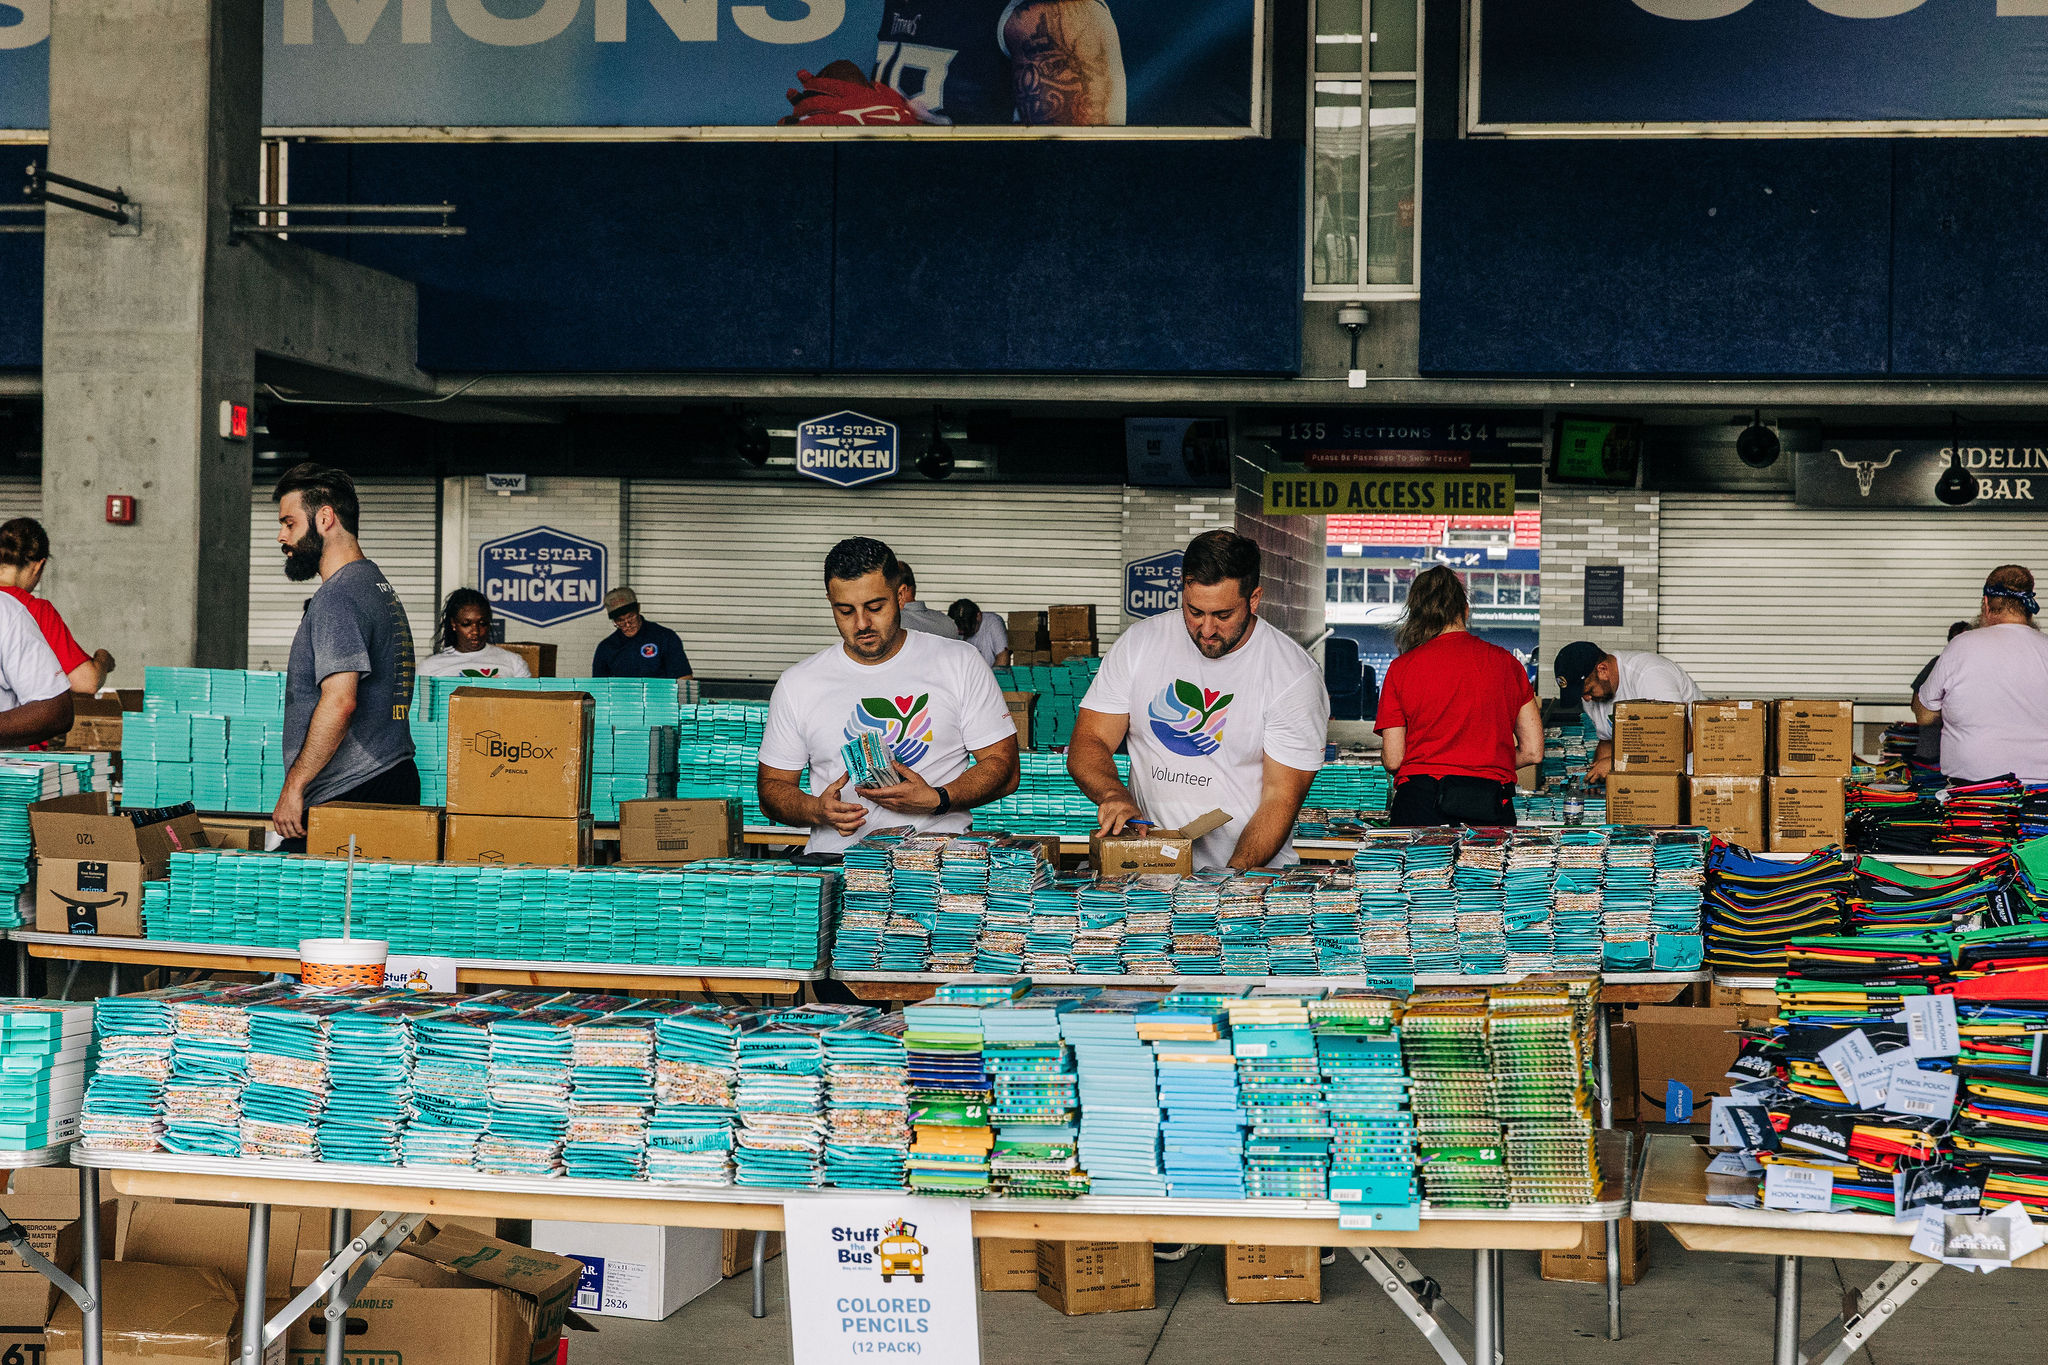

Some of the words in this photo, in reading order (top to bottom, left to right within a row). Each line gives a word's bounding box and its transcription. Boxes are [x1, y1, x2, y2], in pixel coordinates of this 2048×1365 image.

[805, 425, 887, 436] TRI-STAR
[1289, 423, 1327, 440] 135
[1448, 423, 1489, 441] 134
[802, 448, 890, 469] CHICKEN
[1272, 481, 1339, 508] FIELD
[1347, 481, 1436, 508] ACCESS
[1444, 482, 1507, 509] HERE
[1979, 479, 2035, 500] BAR
[490, 548, 593, 561] TRI-STAR
[1134, 566, 1182, 576] TRI-S
[486, 578, 597, 602] CHICKEN
[490, 740, 554, 763] BigBox
[1151, 765, 1213, 787] Volunteer
[76, 833, 95, 845] 120
[384, 972, 408, 982] Stuff
[1935, 1000, 1943, 1027] PENCIL
[1939, 1027, 1948, 1051] POUCH
[1849, 1039, 1864, 1062] PENCIL
[1857, 1066, 1883, 1080] PENCIL
[1897, 1076, 1921, 1088] PENCIL
[1922, 1079, 1950, 1092] POUCH
[965, 1106, 982, 1118] 12
[653, 1136, 694, 1146] PENCILS
[1791, 1127, 1821, 1139] ARCTIC
[1821, 1135, 1847, 1148] STAR
[1479, 1149, 1497, 1160] 12
[1804, 1192, 1826, 1201] PENCIL
[831, 1227, 880, 1242] Stuff
[850, 1243, 865, 1251] the
[838, 1249, 873, 1264] Bus
[604, 1298, 628, 1310] 2826
[837, 1298, 931, 1313] COLORED
[842, 1318, 929, 1333] PENCILS
[852, 1341, 874, 1355] (12
[878, 1341, 922, 1355] PACK)
